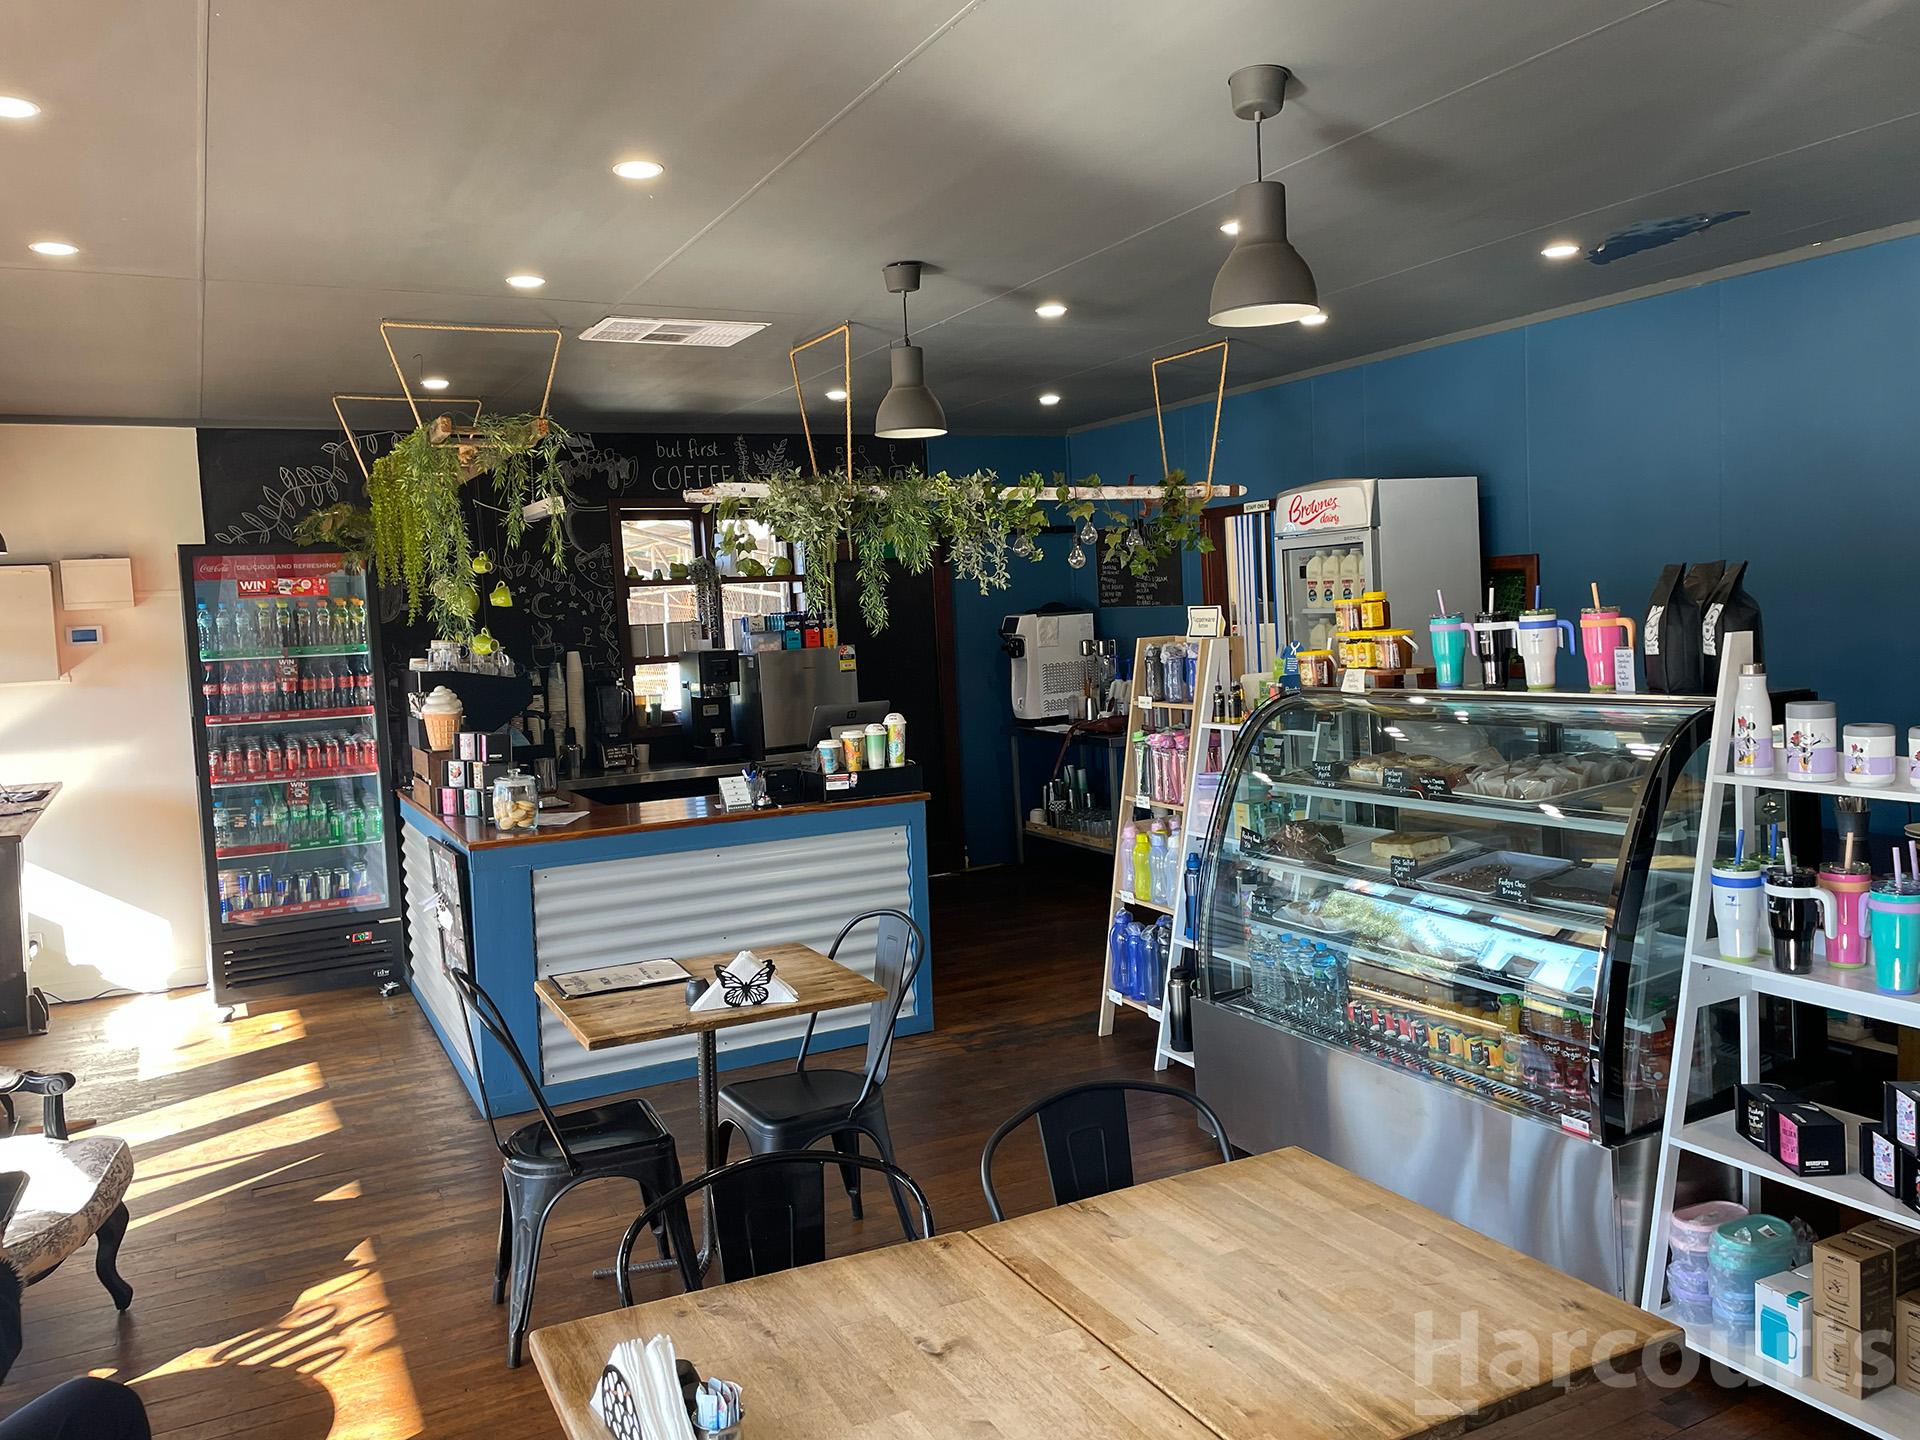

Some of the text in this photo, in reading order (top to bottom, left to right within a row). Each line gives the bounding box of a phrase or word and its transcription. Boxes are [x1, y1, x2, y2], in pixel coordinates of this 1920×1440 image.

[655, 439, 682, 458] but
[1288, 494, 1338, 524] Brownes
[1319, 513, 1340, 525] dairy
[236, 562, 337, 572] DELICIOUS AND REFRESHING
[239, 580, 267, 591] WIN
[278, 658, 295, 666] WIN
